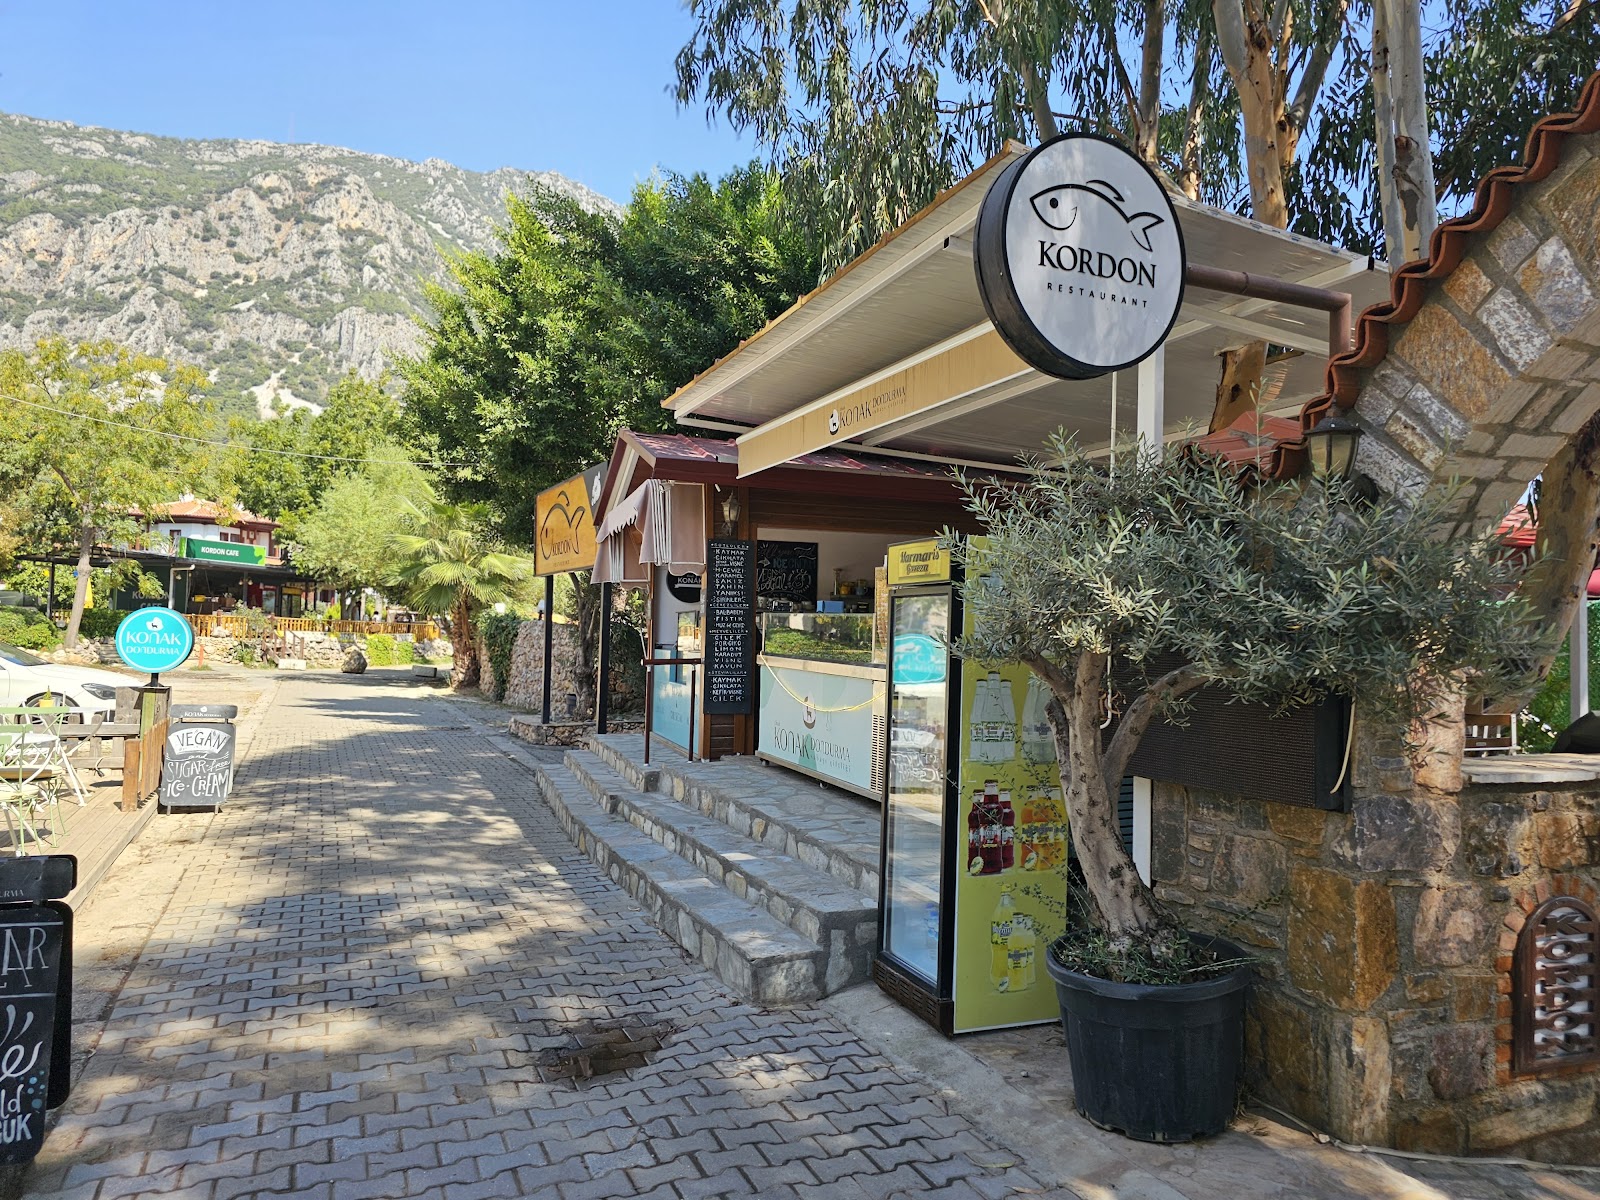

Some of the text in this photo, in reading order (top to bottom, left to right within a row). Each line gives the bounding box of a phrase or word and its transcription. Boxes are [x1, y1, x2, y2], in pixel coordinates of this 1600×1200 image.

[1038, 240, 1157, 288] KORDON
[1047, 282, 1147, 308] RESTAURANT
[839, 400, 872, 428] KONAK
[201, 546, 239, 557] KORDON CAFE
[715, 548, 745, 556] KAYMAK
[126, 631, 181, 645] KONAK
[126, 645, 180, 656] DONDURMA
[176, 731, 227, 750] VEGAN
[774, 726, 810, 760] KONAK
[191, 768, 229, 798] CREAM
